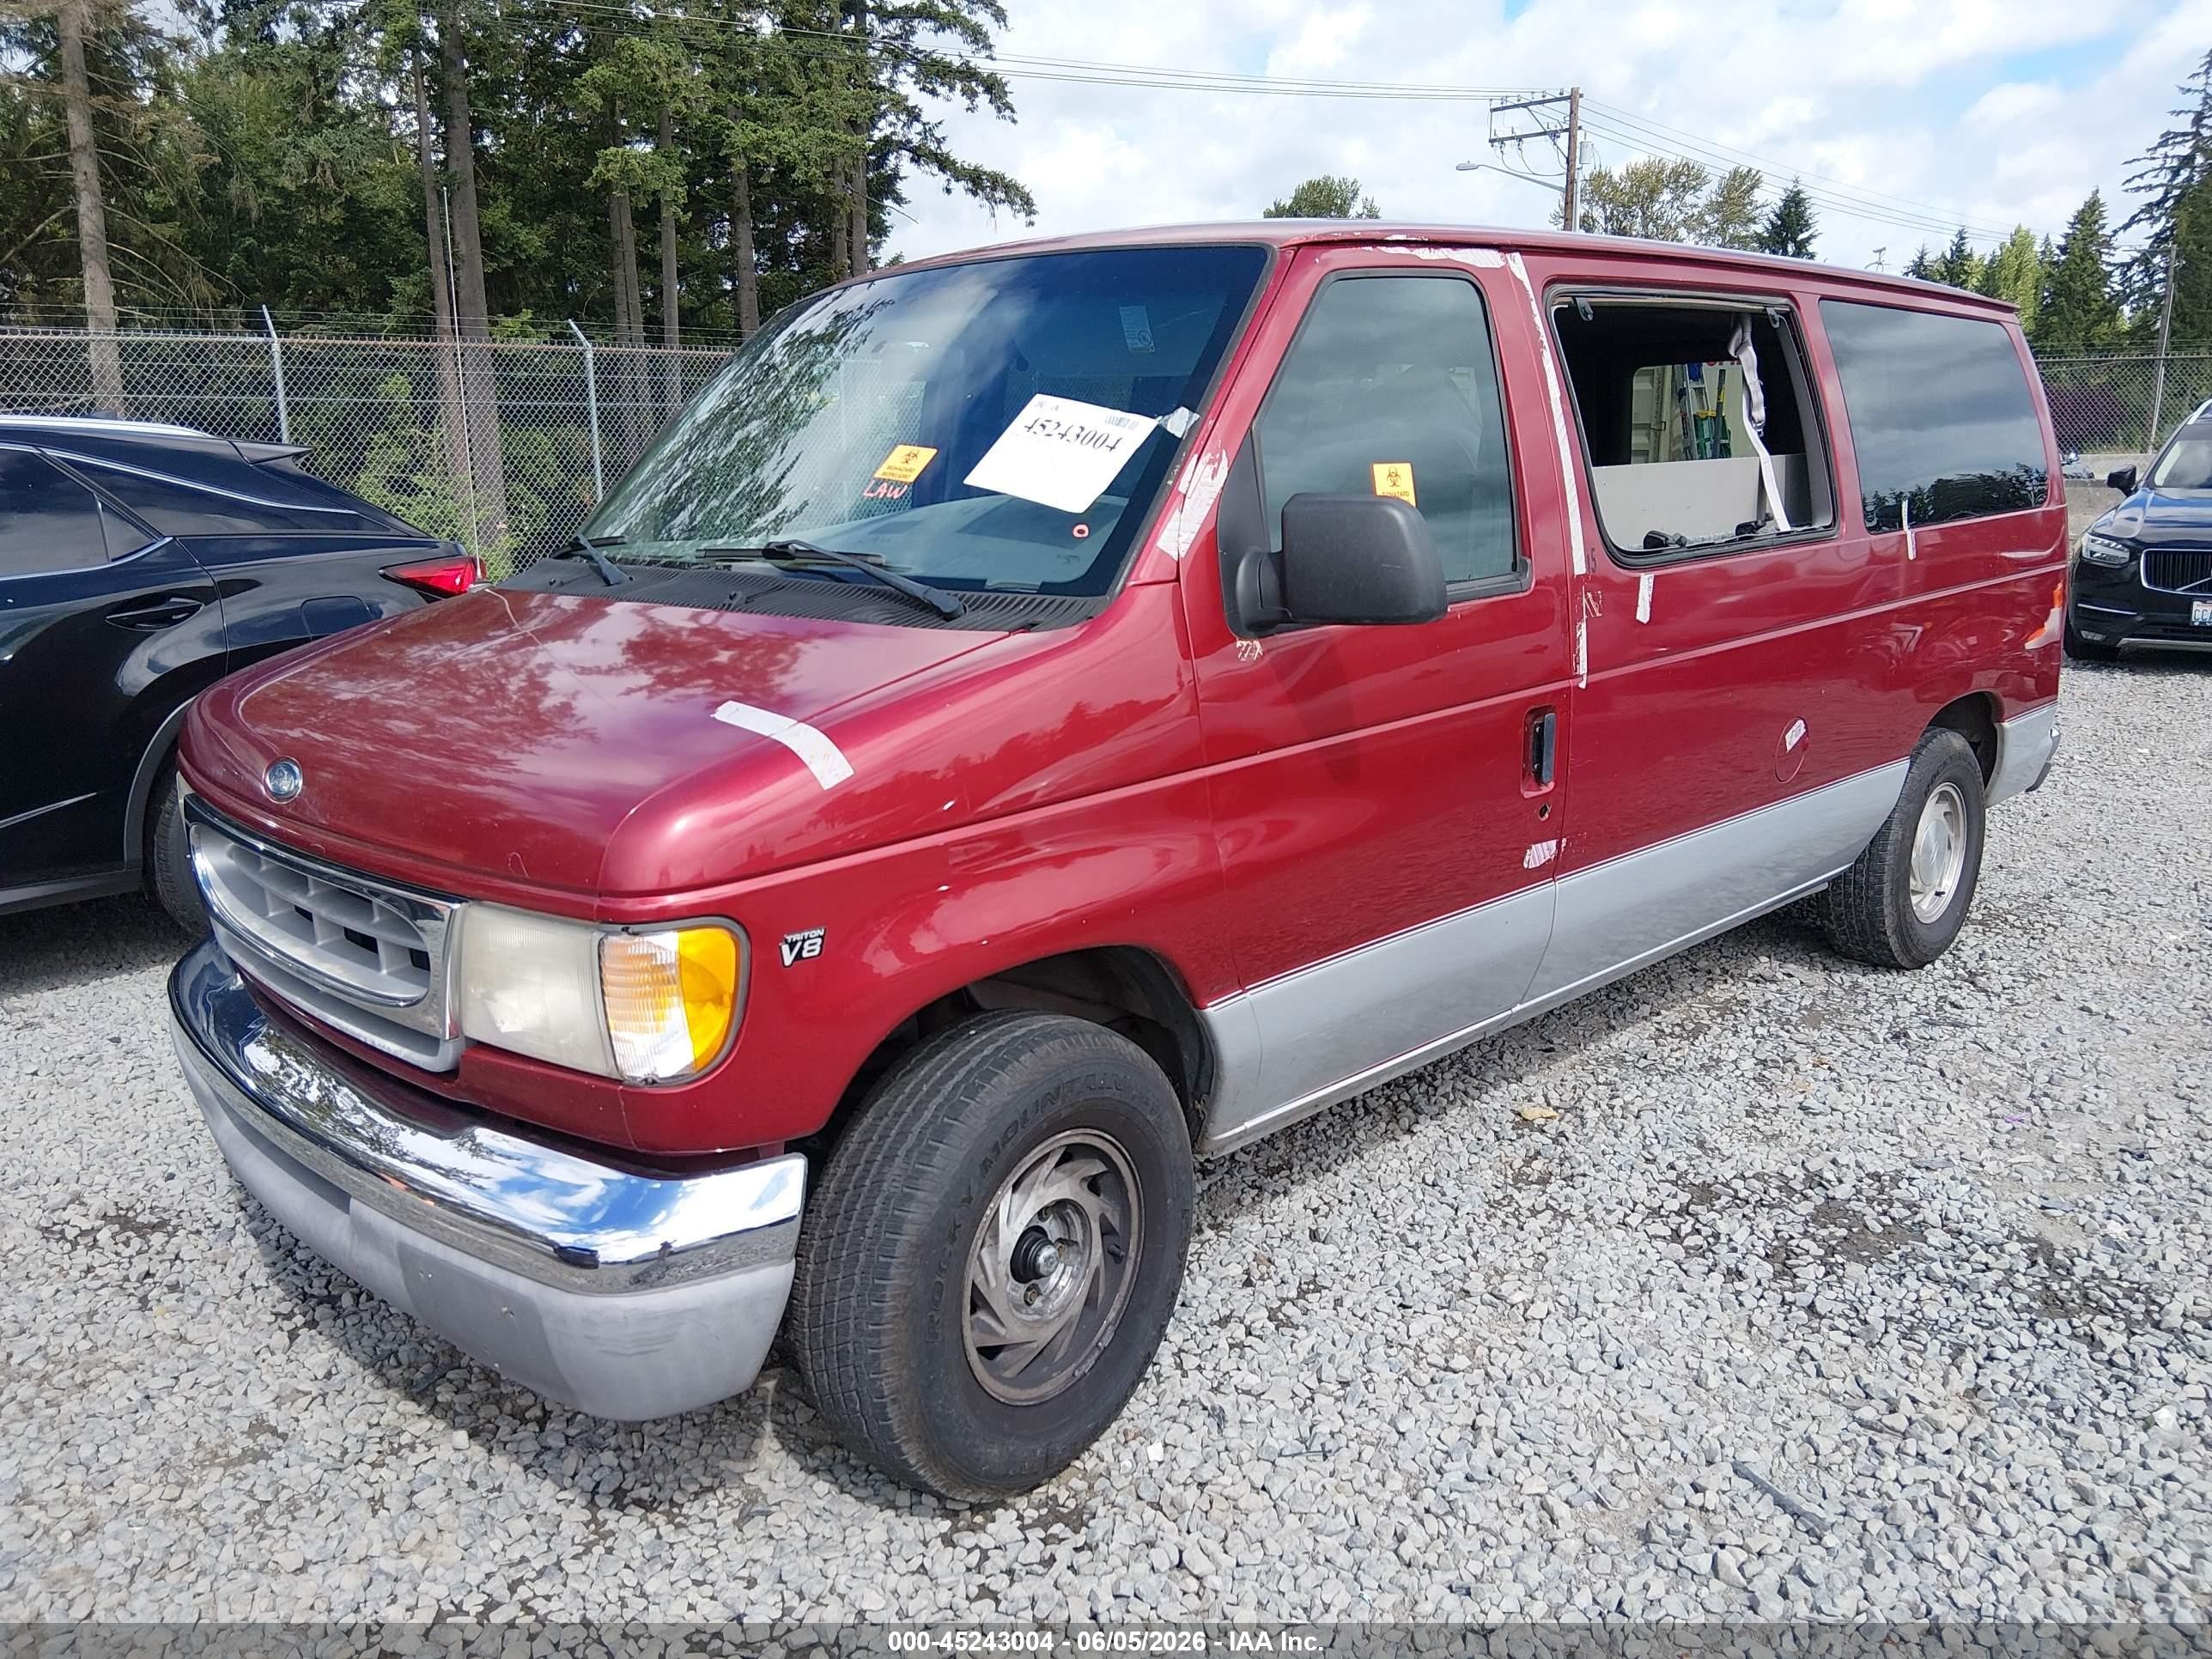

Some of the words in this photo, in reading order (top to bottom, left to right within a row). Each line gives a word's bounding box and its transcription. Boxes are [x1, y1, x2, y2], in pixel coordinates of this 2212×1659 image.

[1024, 417, 1123, 453] 45243004
[784, 927, 825, 943] TRITON
[780, 937, 823, 967] V8
